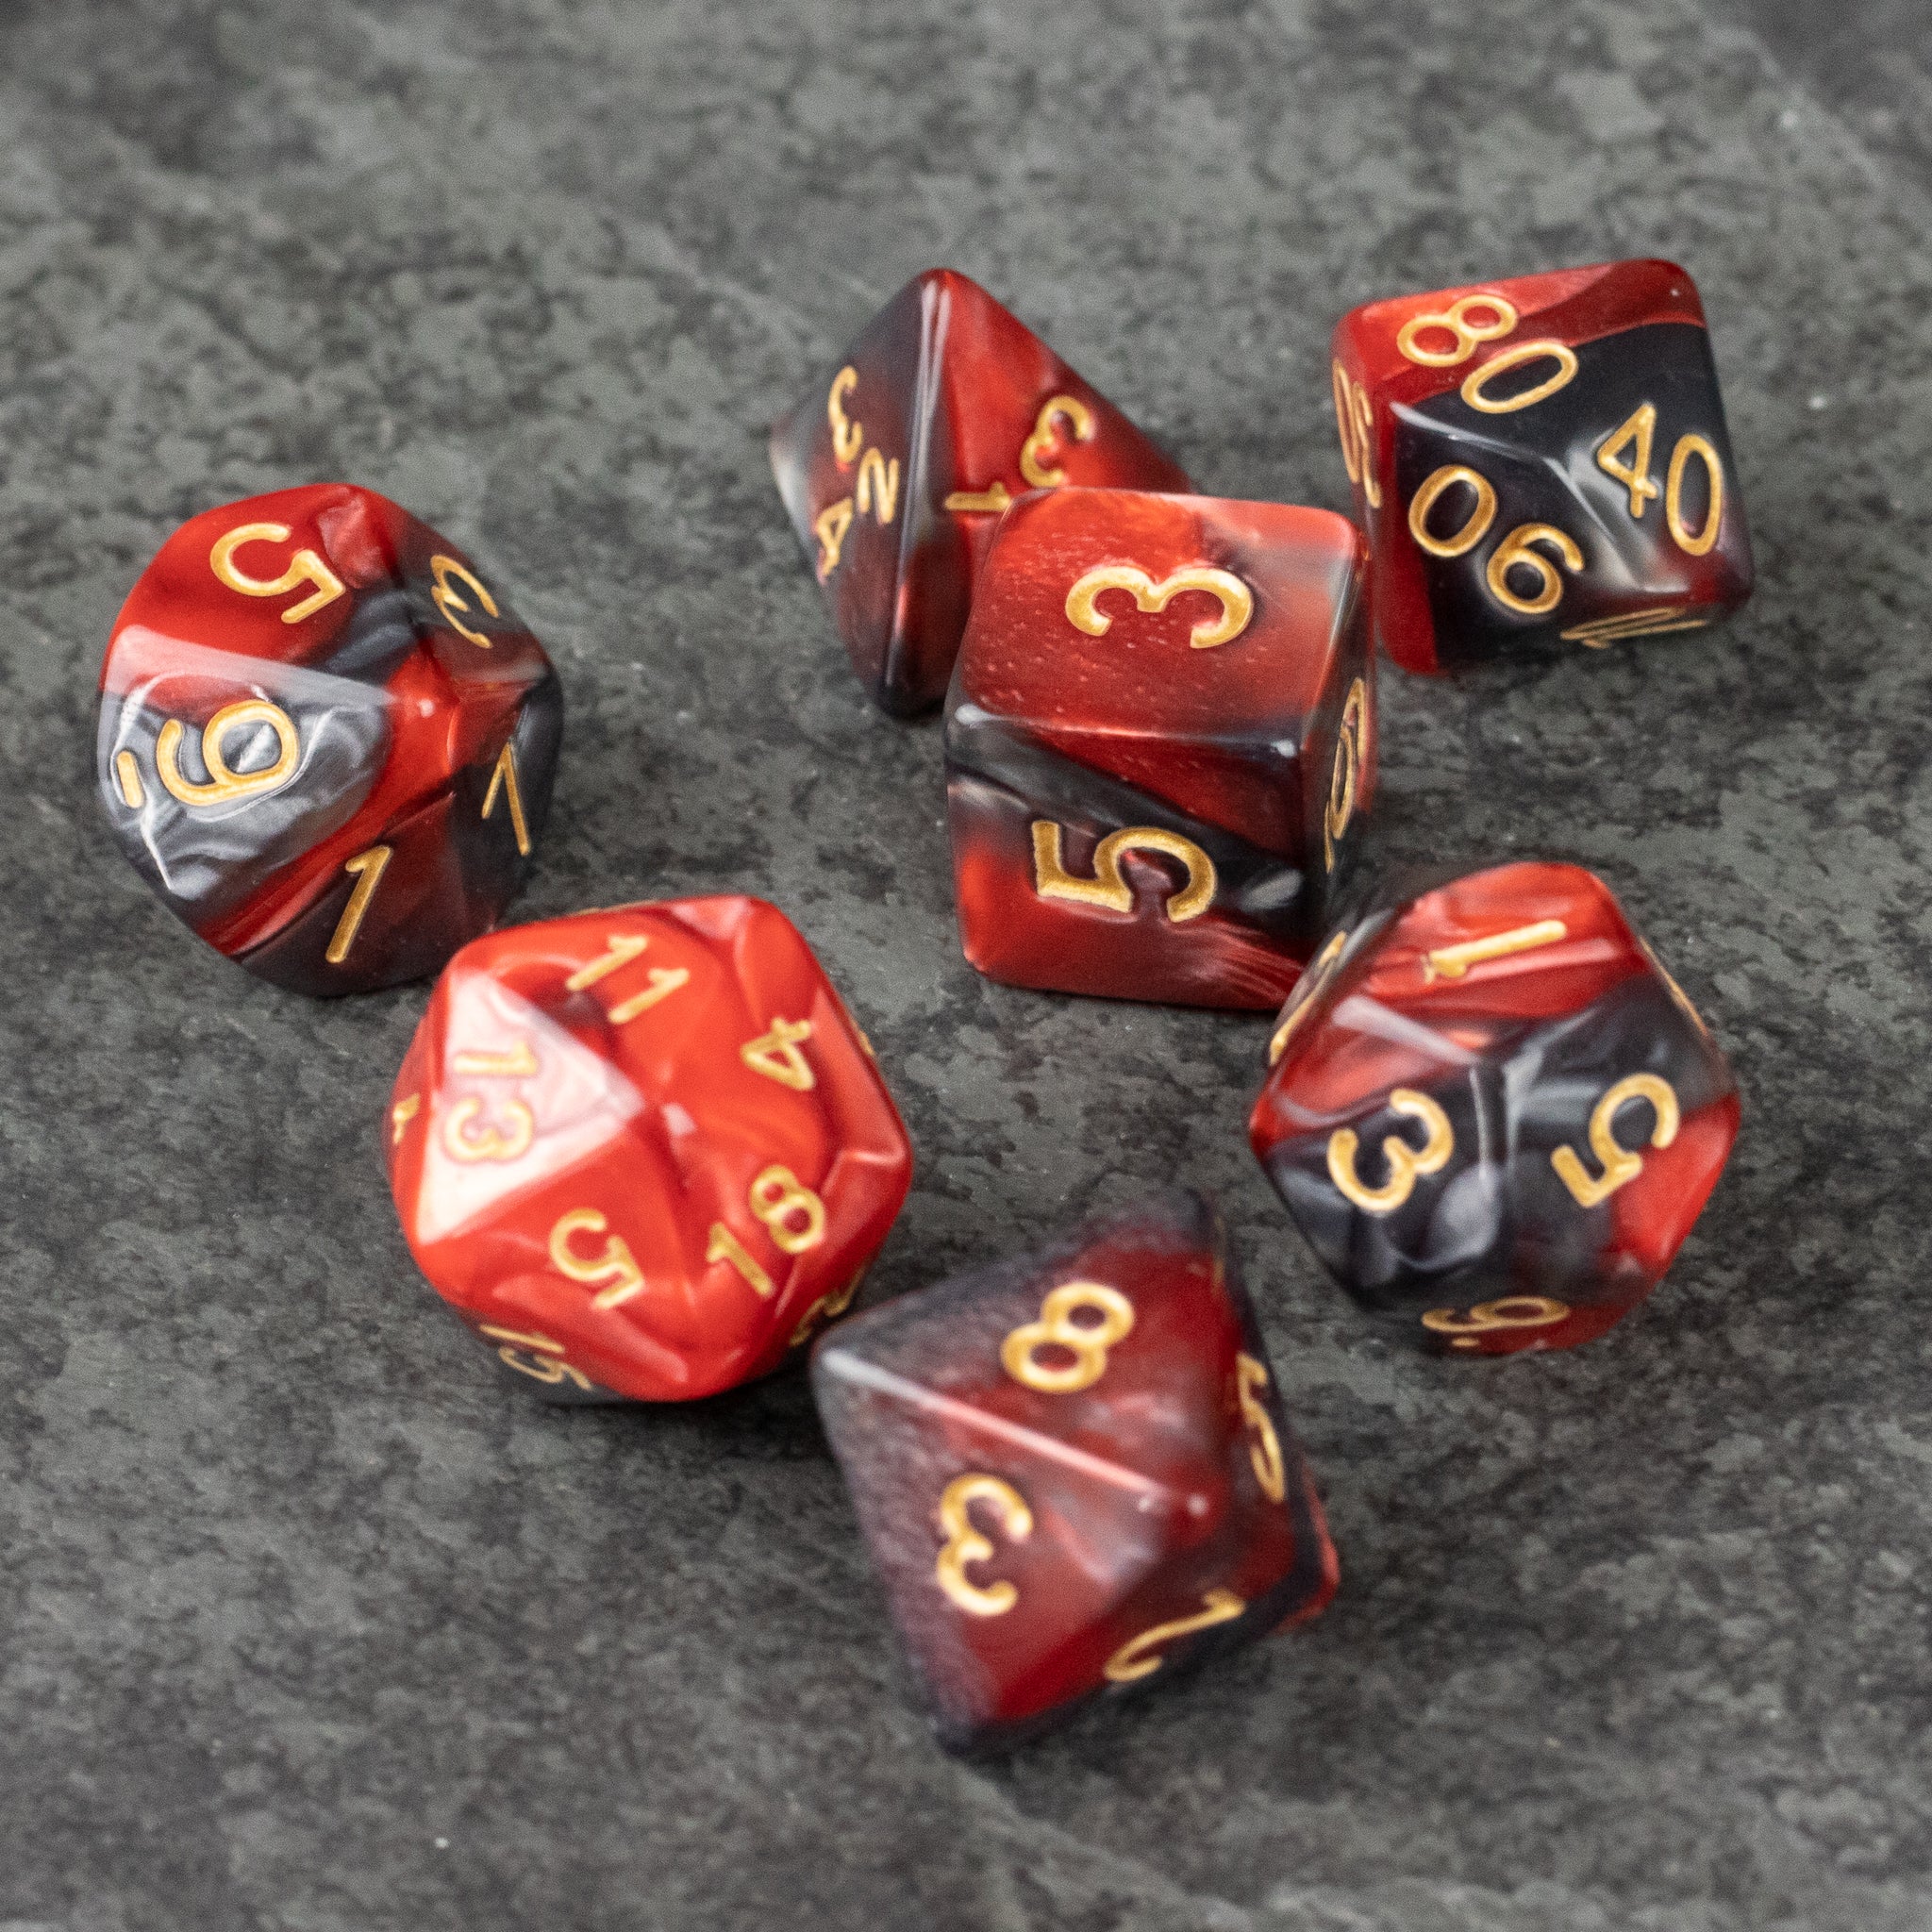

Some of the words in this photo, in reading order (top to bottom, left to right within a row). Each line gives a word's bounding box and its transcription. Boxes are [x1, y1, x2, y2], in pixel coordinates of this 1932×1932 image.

[1394, 292, 1582, 415] 80
[826, 364, 863, 464] 3
[1020, 395, 1096, 488] 3
[856, 445, 899, 525] 2
[1594, 401, 1723, 557] 40
[209, 522, 346, 624] 5
[812, 493, 853, 579] 4
[430, 555, 500, 649] 3
[1064, 566, 1255, 649] 3
[325, 844, 392, 964] 1
[1030, 819, 1219, 924] 5
[566, 934, 692, 1024] 11
[443, 1042, 536, 1162] 13
[740, 1017, 815, 1092] 4
[1326, 1087, 1455, 1213] 3
[1549, 1072, 1679, 1209] 5
[549, 1208, 645, 1309] 5
[706, 1164, 826, 1298] 18
[1000, 1281, 1134, 1392] 8
[936, 1474, 1033, 1617] 3
